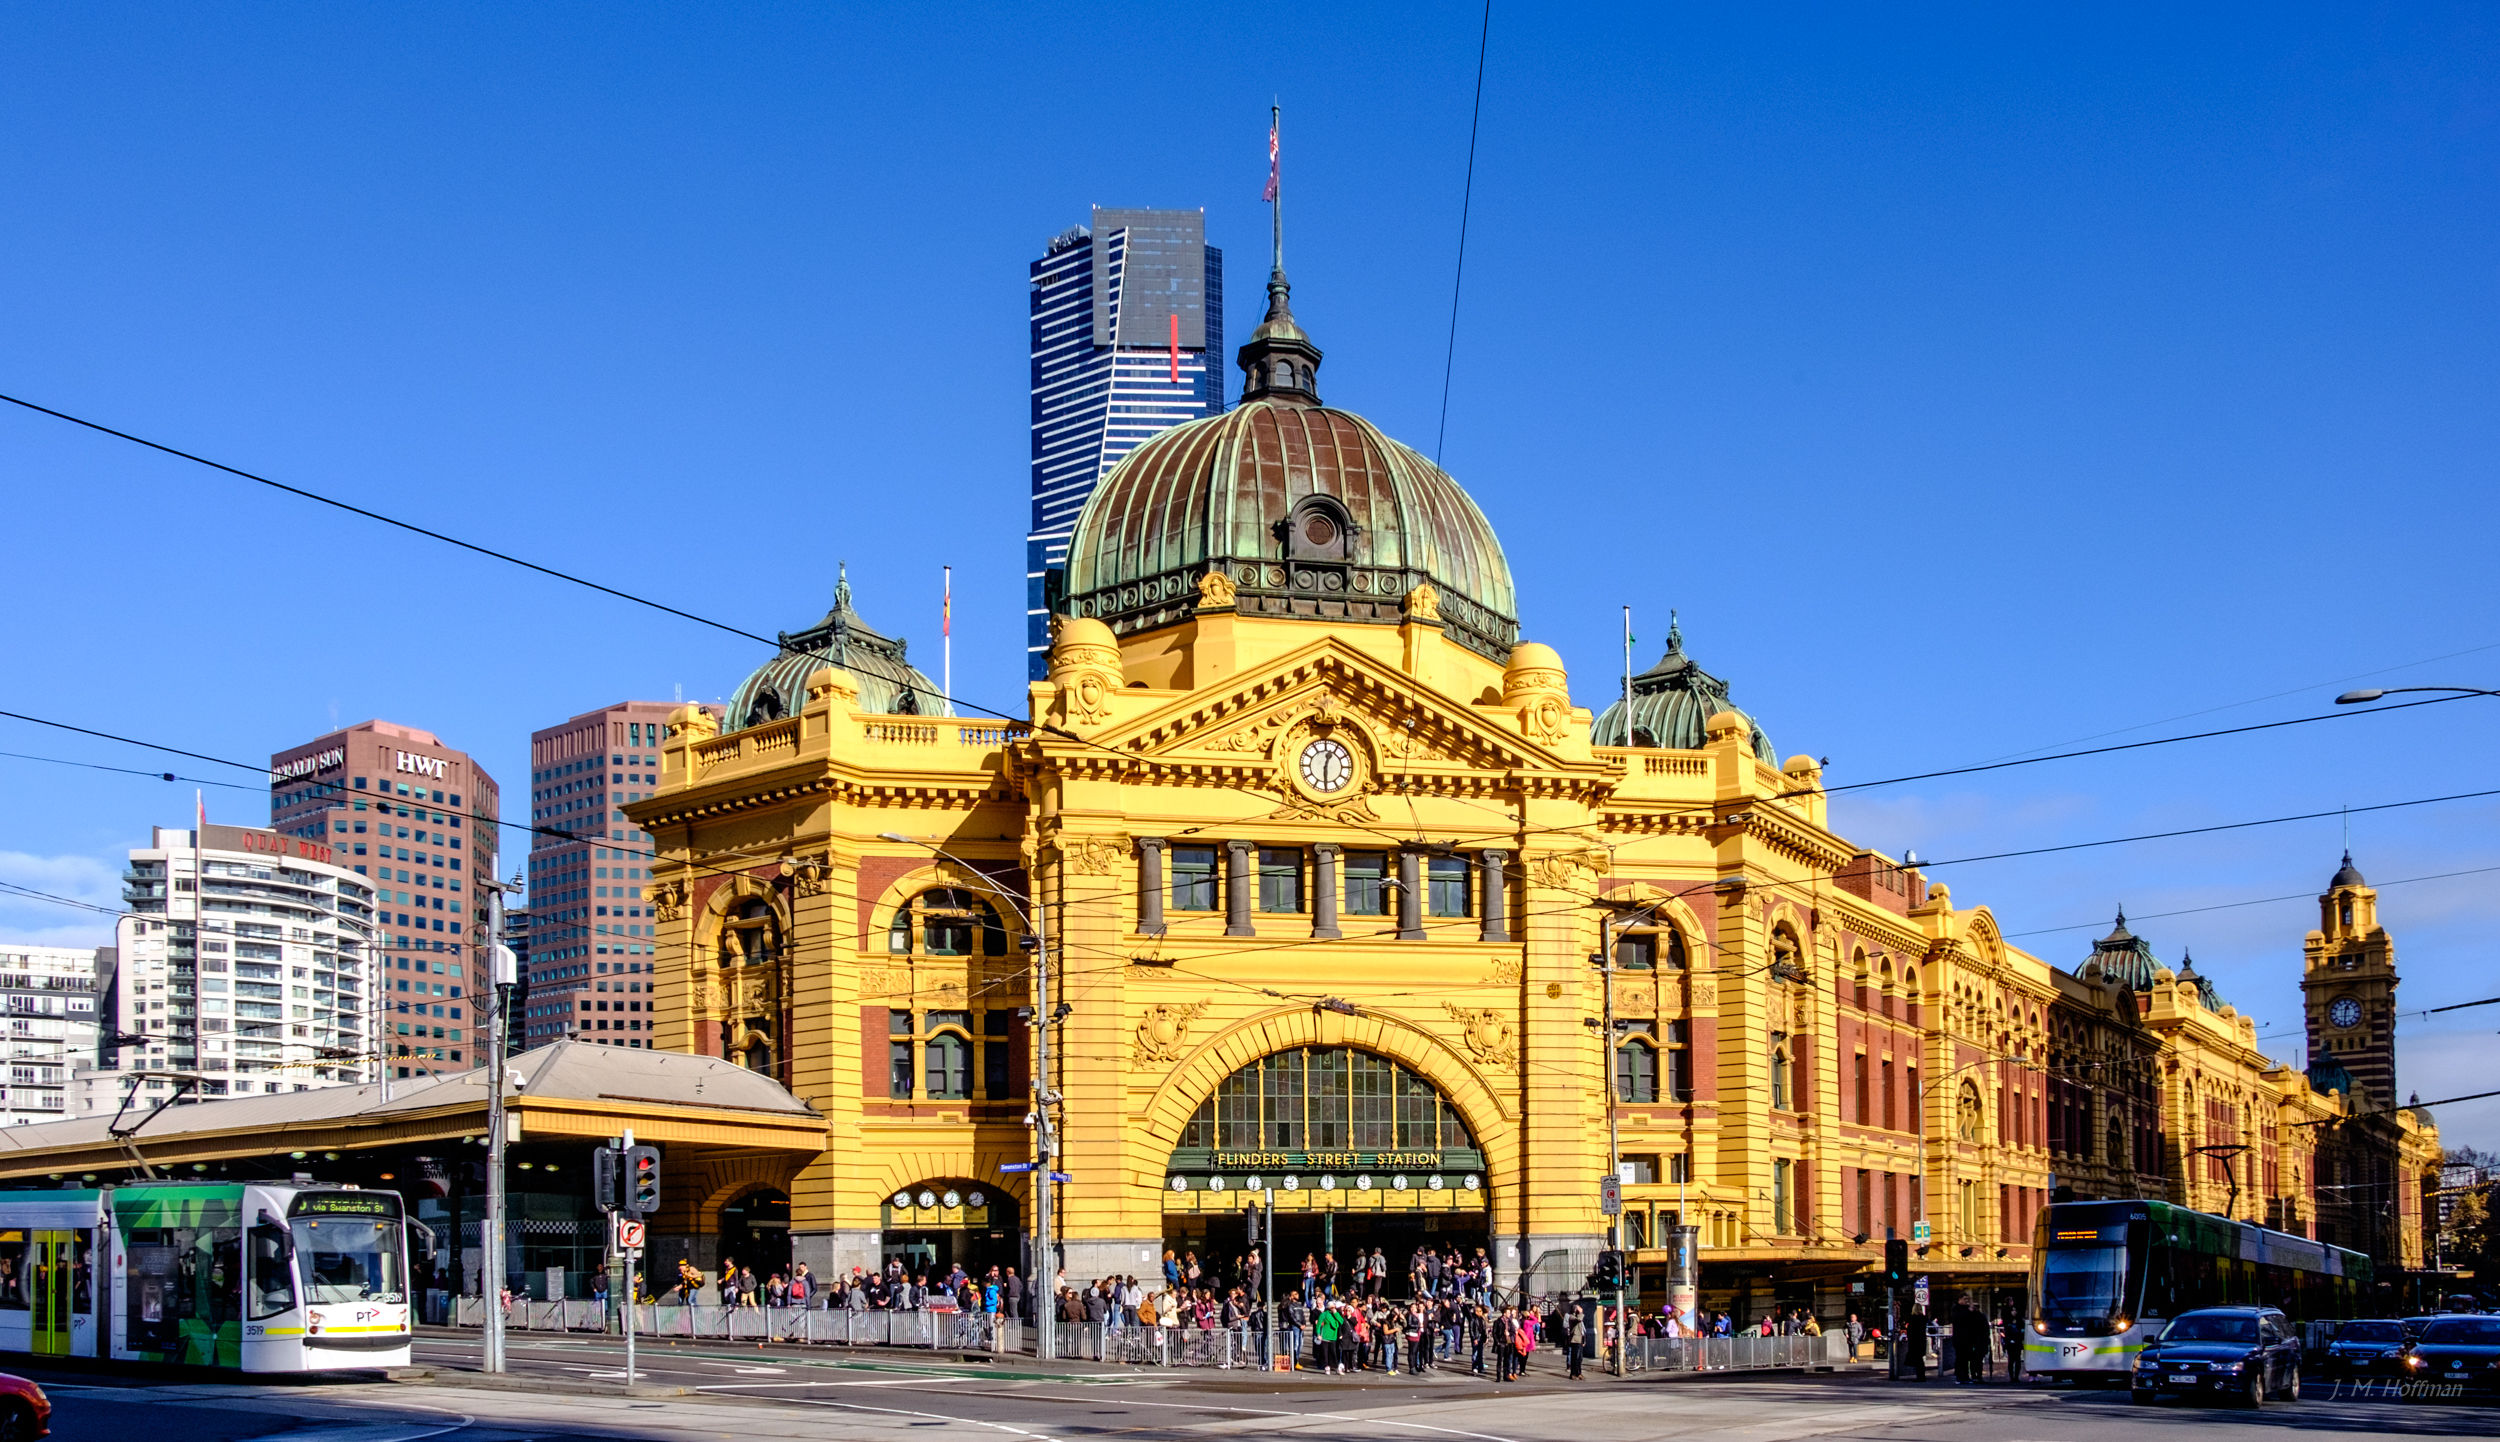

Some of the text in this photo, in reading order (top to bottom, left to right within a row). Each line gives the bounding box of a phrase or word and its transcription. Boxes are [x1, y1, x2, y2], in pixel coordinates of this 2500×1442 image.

[269, 747, 344, 784] HERALD SUN
[396, 751, 448, 779] HWT
[243, 832, 333, 864] QUAY WEST
[1547, 983, 1560, 991] CUT
[1218, 1153, 1441, 1165] FLINDERS STREET STATION
[313, 1204, 326, 1212] via
[330, 1204, 371, 1212] Swanston
[374, 1204, 384, 1213] St
[245, 1325, 264, 1336] 3519
